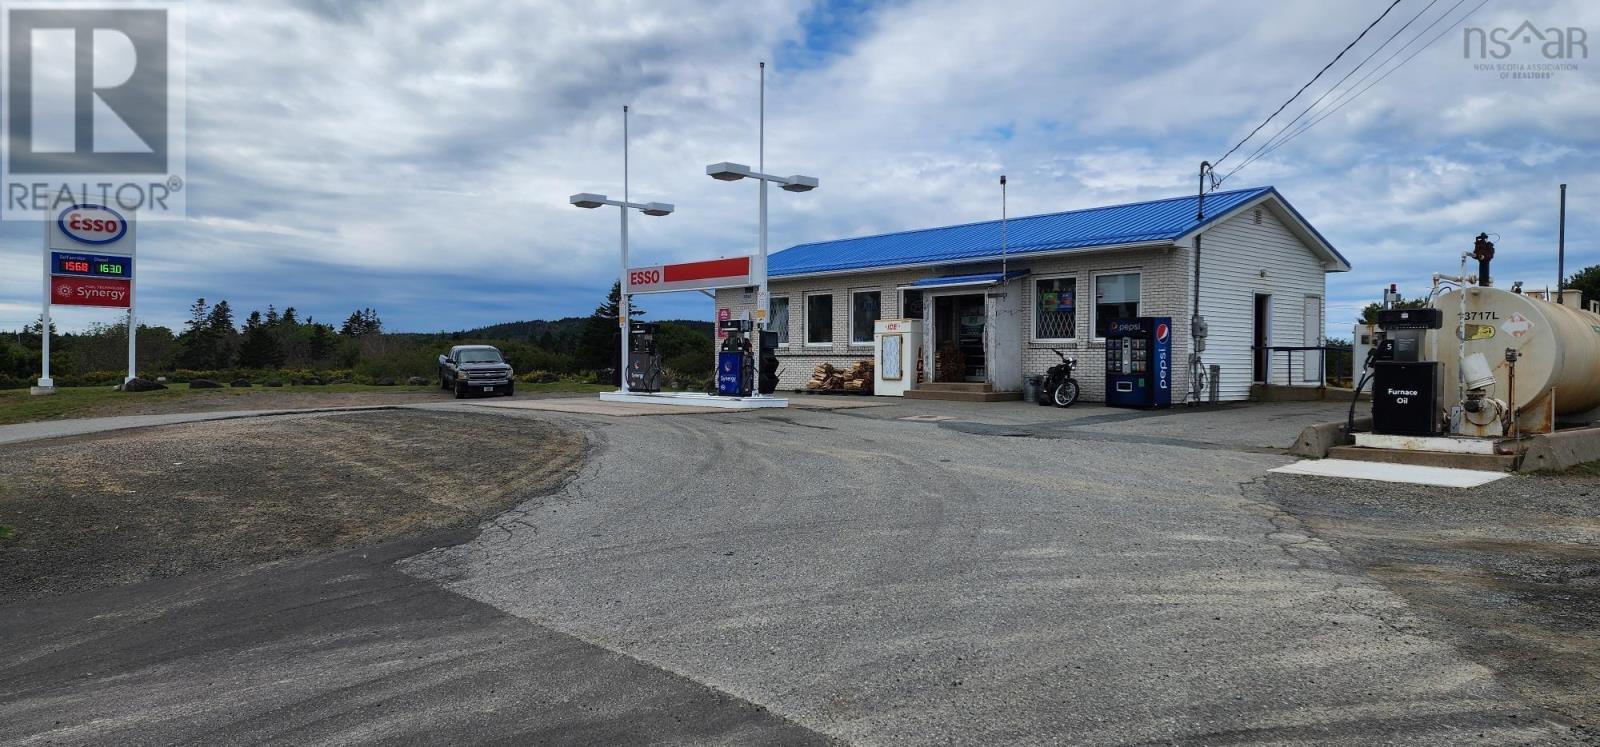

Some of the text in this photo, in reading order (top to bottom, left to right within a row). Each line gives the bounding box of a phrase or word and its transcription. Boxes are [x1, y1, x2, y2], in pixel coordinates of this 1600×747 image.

[630, 270, 660, 285] ESSO
[77, 287, 125, 300] Synergy
[1119, 323, 1141, 331] pepsi
[1158, 348, 1168, 389] pepsi
[1388, 388, 1418, 396] Furnace
